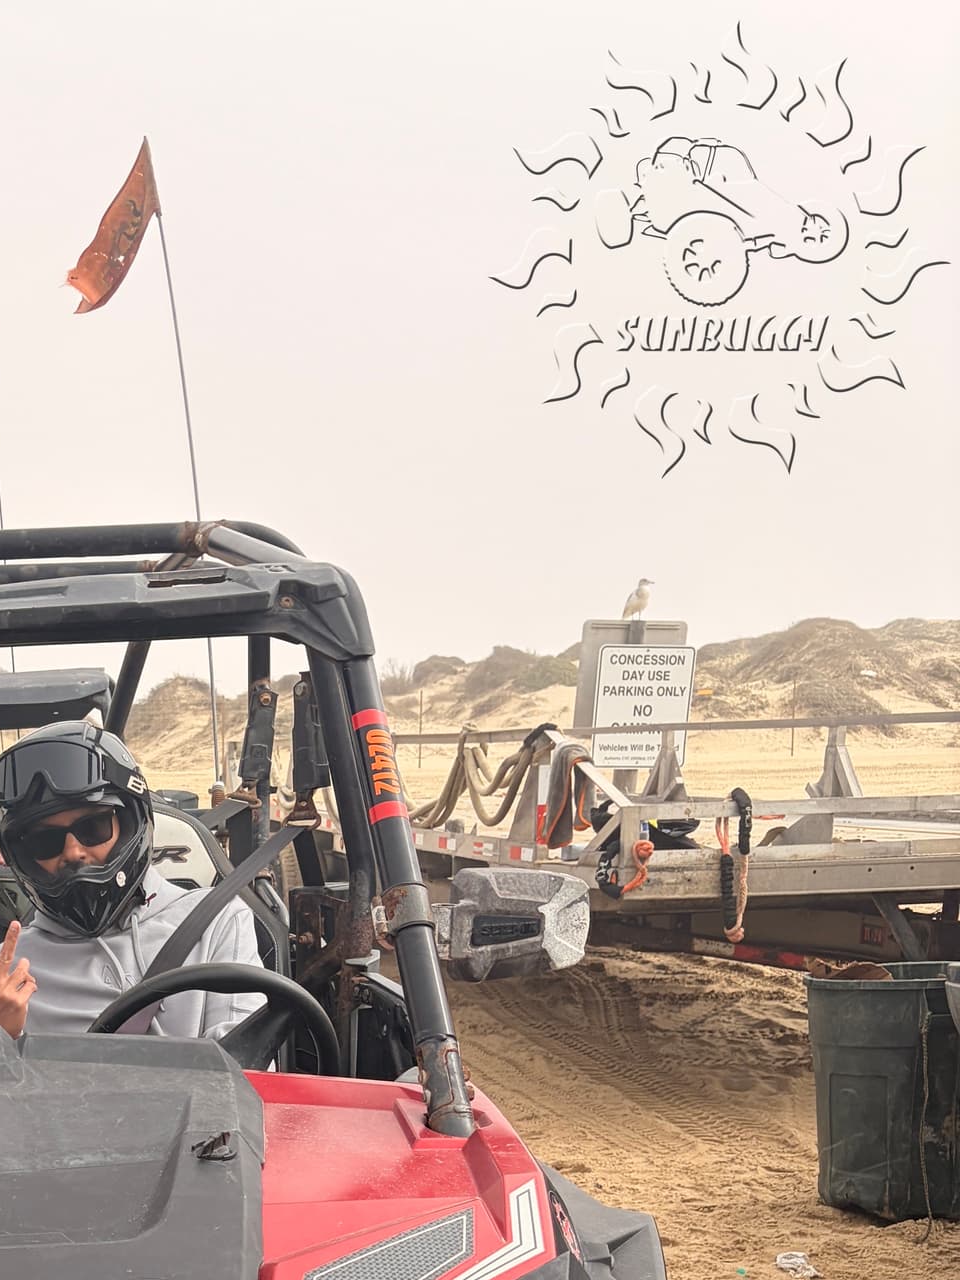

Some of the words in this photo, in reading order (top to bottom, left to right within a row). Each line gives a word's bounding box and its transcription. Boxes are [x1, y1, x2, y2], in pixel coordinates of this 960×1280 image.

[609, 653, 686, 666] CONCESSION
[621, 669, 645, 681] DAY
[647, 670, 671, 681] USE
[602, 685, 654, 697] PARKING
[656, 686, 687, 697] ONLY
[632, 704, 653, 717] NO
[598, 743, 629, 752] Vehicles
[630, 743, 644, 752] Will
[645, 743, 656, 752] Be
[366, 729, 401, 796] 02412
